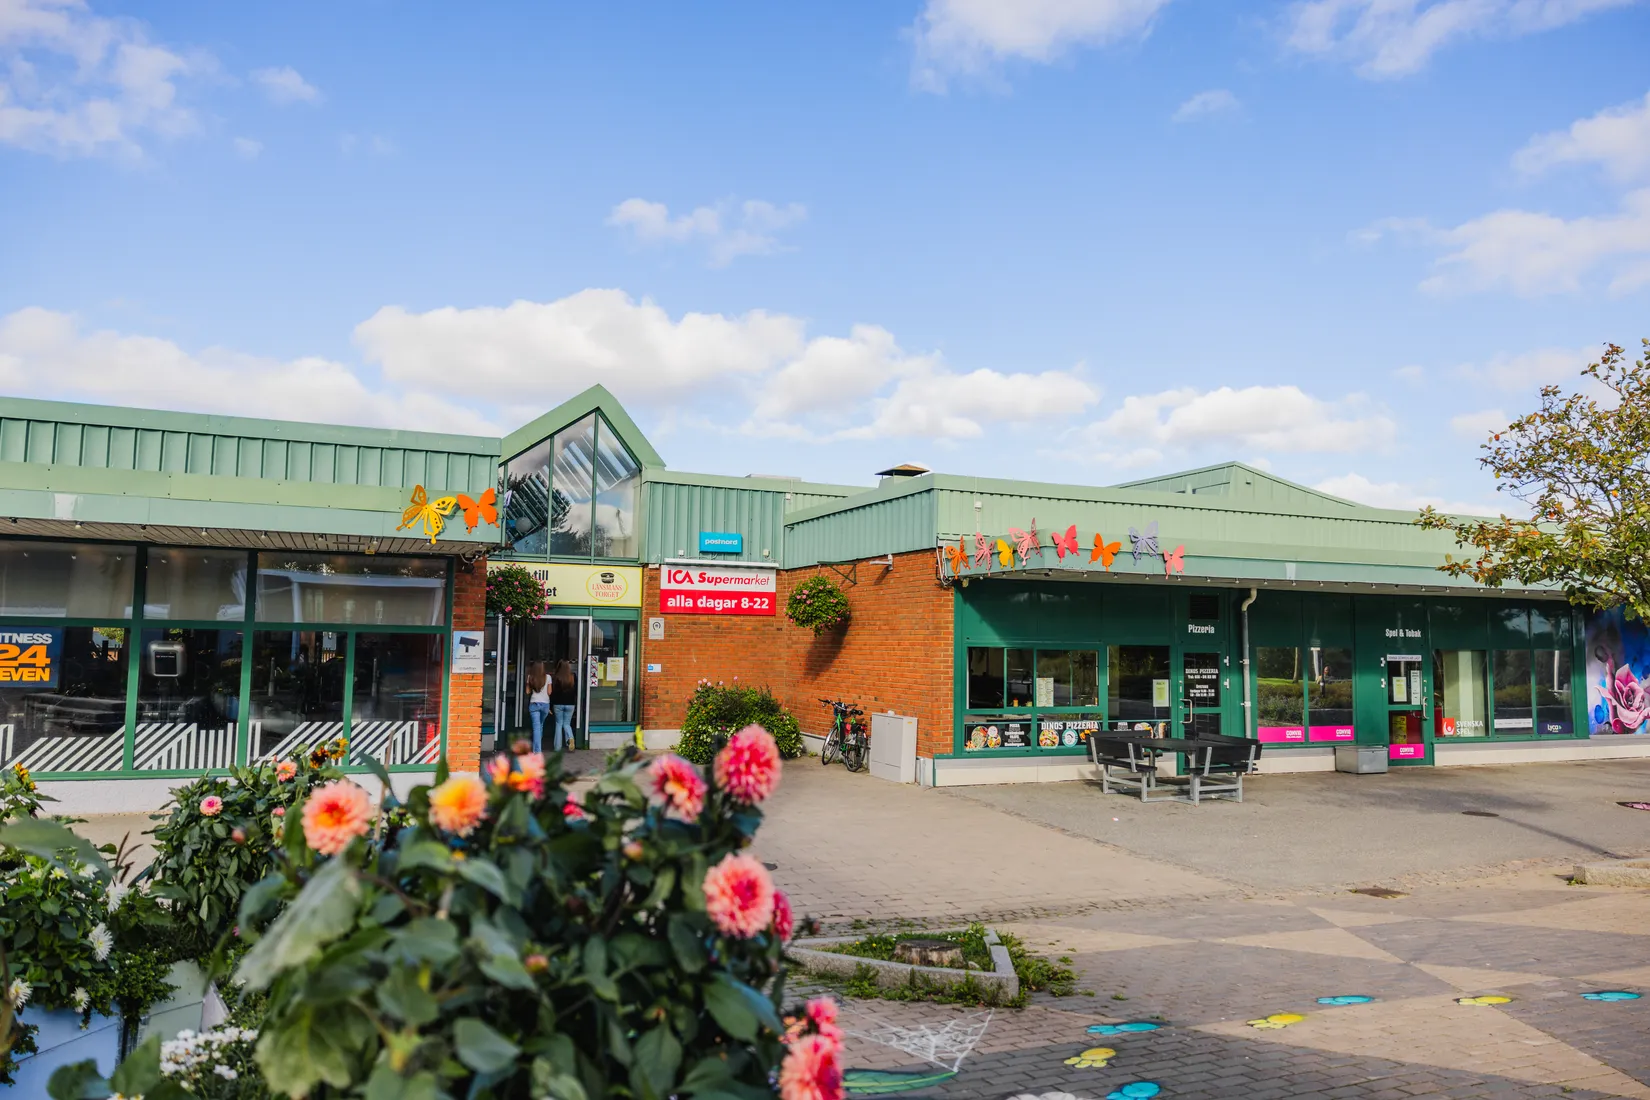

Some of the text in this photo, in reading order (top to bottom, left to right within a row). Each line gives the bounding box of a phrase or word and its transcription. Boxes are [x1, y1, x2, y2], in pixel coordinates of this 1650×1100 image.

[704, 538, 738, 546] postnord
[533, 570, 549, 581] till
[667, 569, 770, 586] ICA Supermarket
[667, 594, 769, 611] alla dagar 8-22
[1188, 624, 1215, 634] Pizzeria
[1385, 628, 1398, 638] Spel
[1399, 628, 1405, 638] &
[0, 644, 51, 667] 24
[1041, 720, 1099, 730] DINOS PIZZERIA
[1456, 720, 1484, 728] SVENSKA
